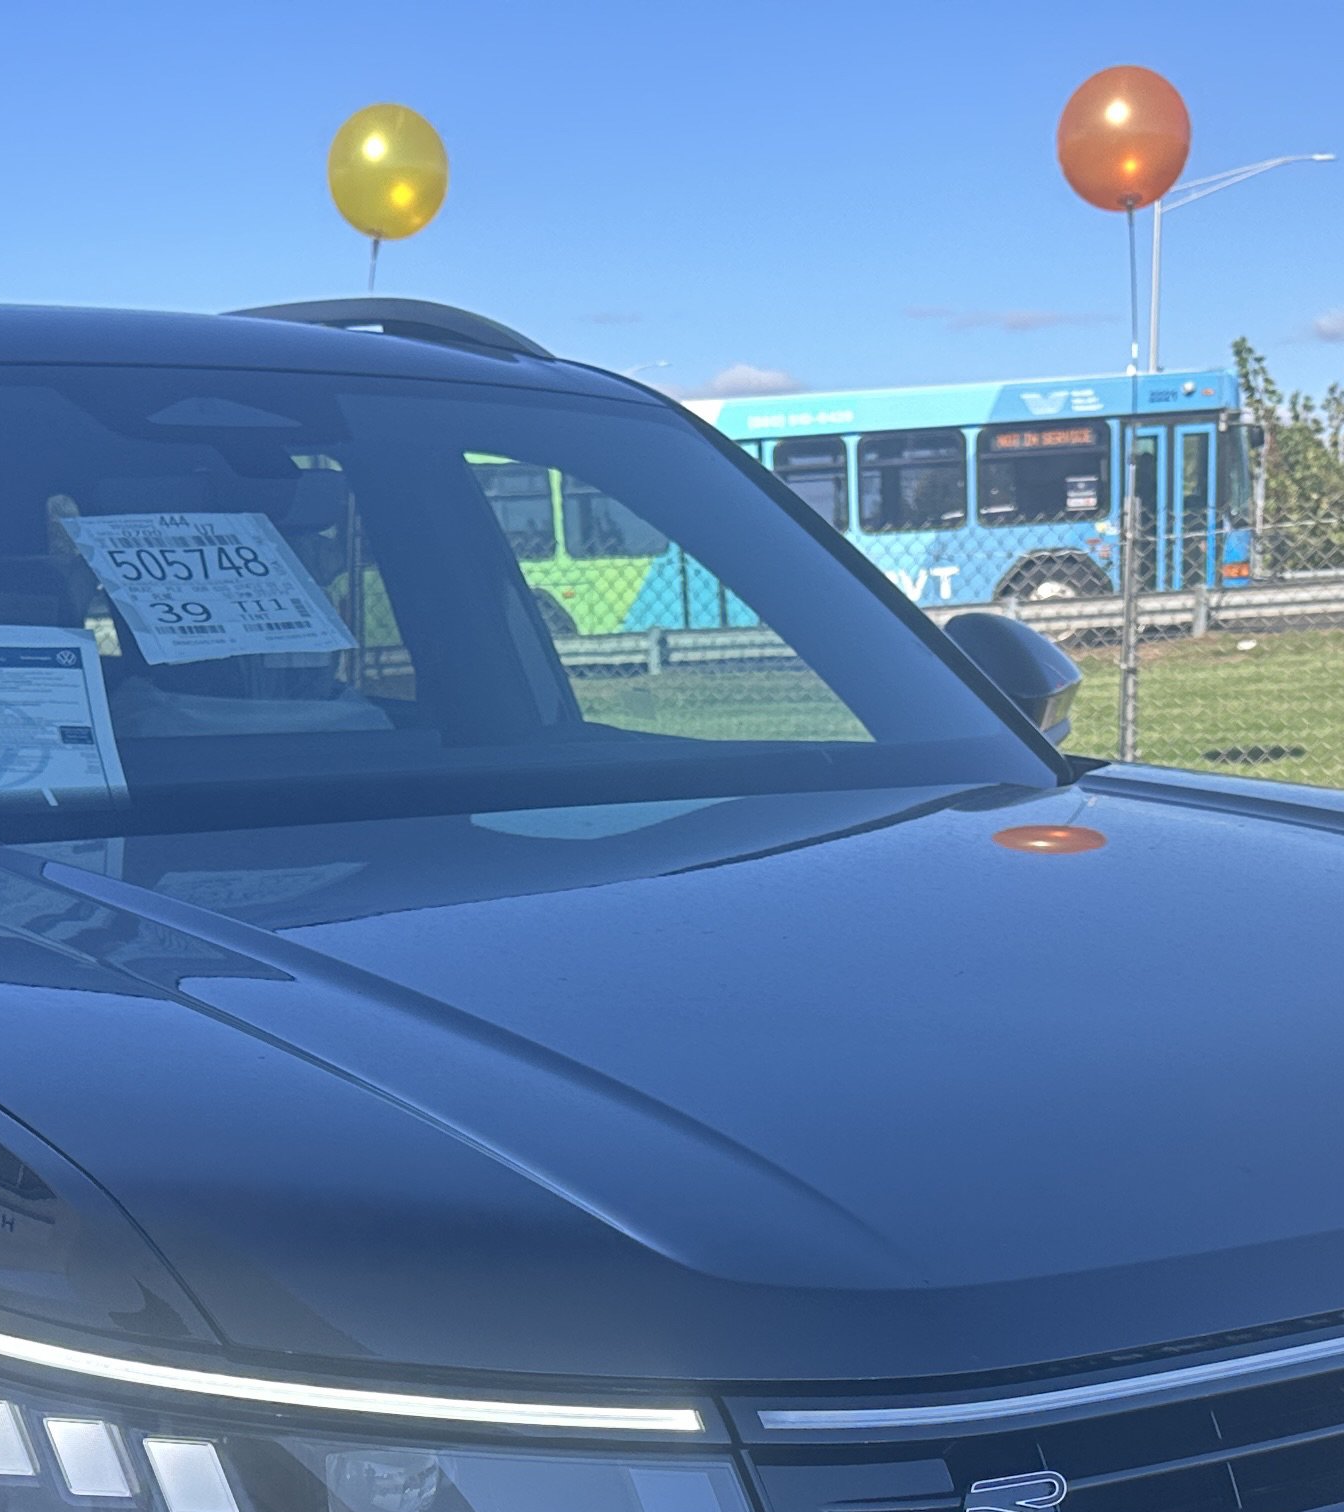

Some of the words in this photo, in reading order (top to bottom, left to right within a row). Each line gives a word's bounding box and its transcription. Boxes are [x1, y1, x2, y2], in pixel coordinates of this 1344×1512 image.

[996, 432, 1019, 449] NOT
[1023, 432, 1039, 448] IN
[1041, 427, 1093, 446] SERVICE
[107, 546, 269, 581] 505748
[149, 601, 212, 624] 39
